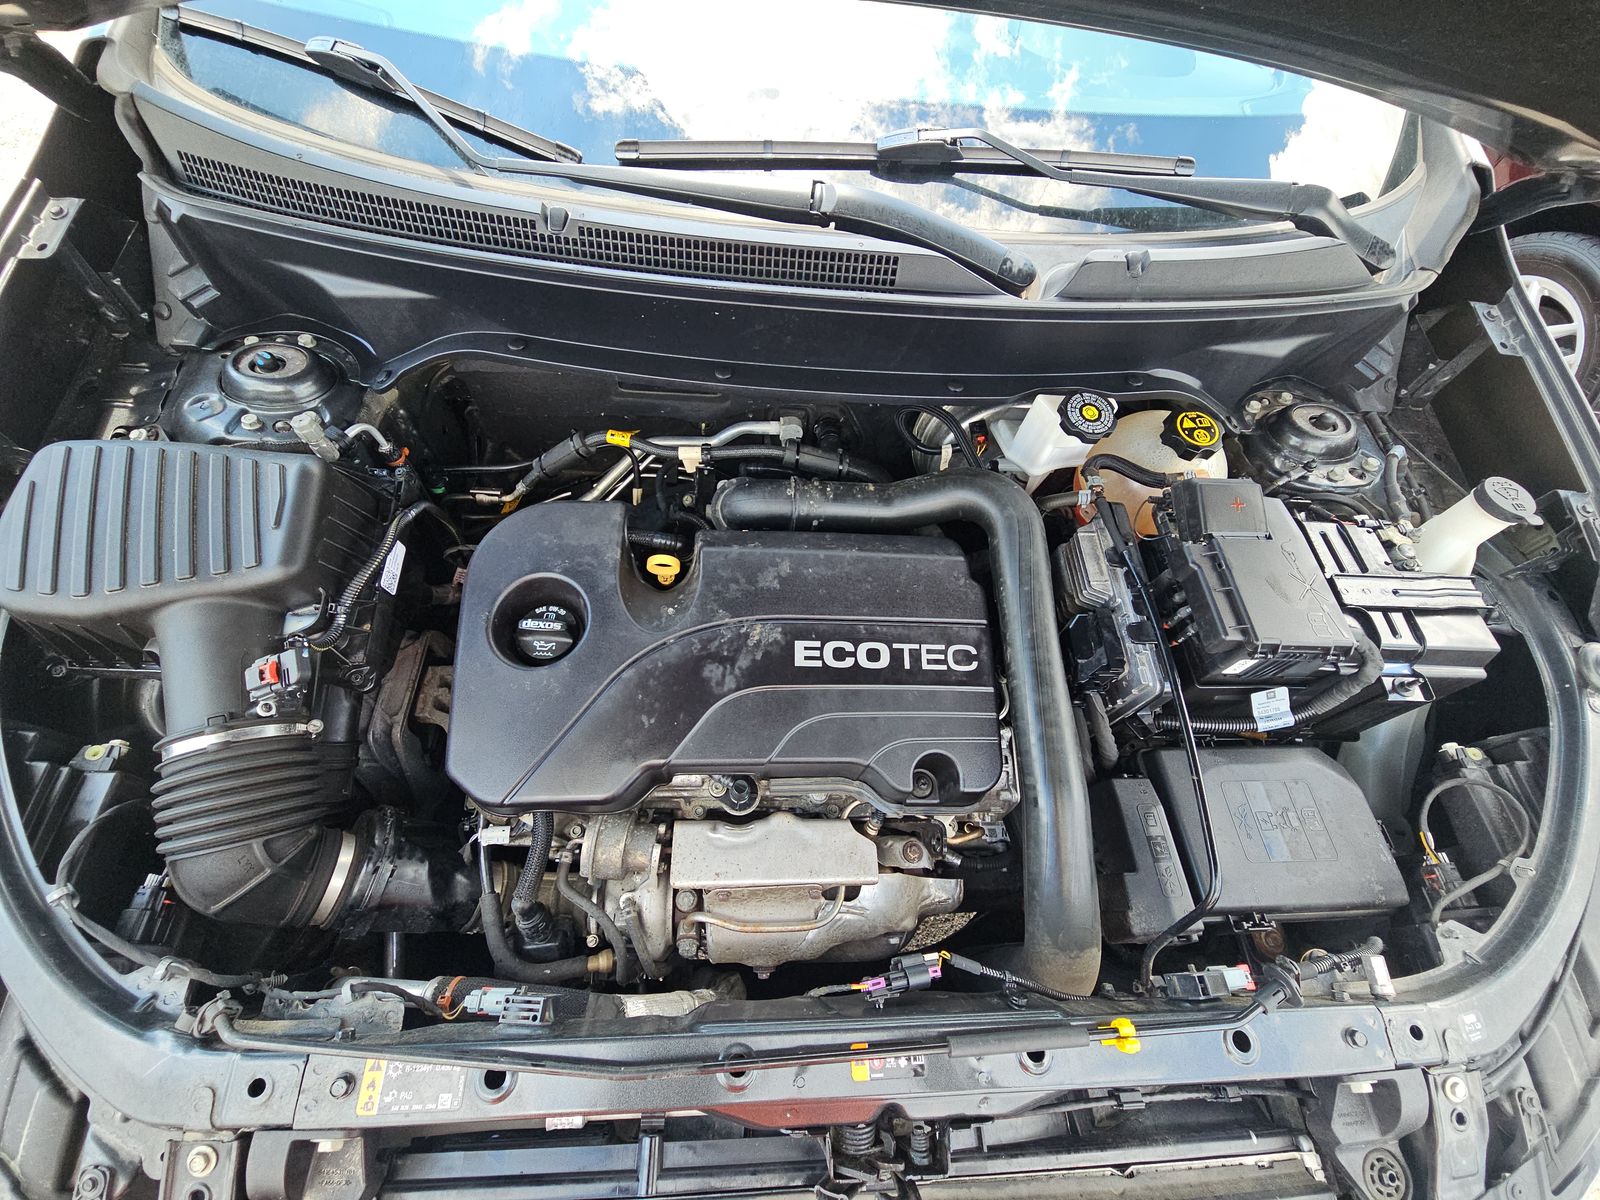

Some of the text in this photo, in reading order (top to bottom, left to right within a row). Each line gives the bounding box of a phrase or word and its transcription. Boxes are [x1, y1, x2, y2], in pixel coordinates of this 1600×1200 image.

[522, 618, 563, 630] dexos
[794, 640, 979, 672] ECOTEC
[399, 1091, 413, 1100] PAG
